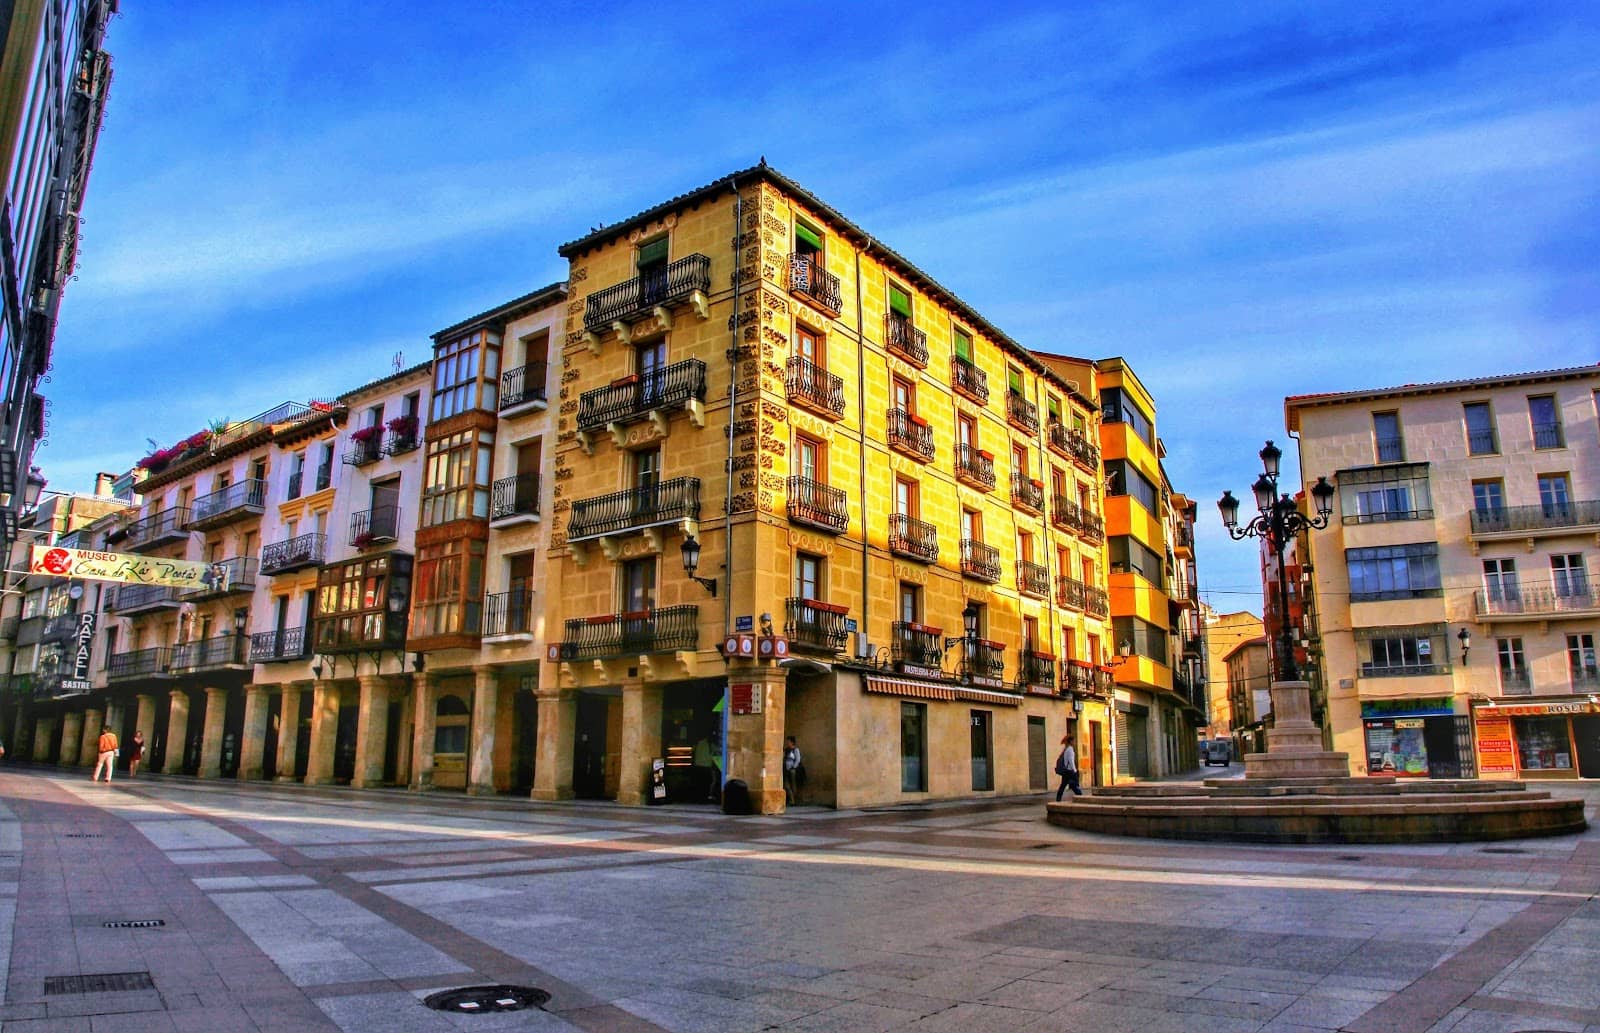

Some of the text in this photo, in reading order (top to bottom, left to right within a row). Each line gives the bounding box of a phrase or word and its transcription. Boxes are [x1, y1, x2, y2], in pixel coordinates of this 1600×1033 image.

[77, 550, 117, 562] MUSEO
[75, 560, 106, 576] Casa
[74, 614, 94, 679] RAFAEL
[62, 680, 92, 690] SASTRE
